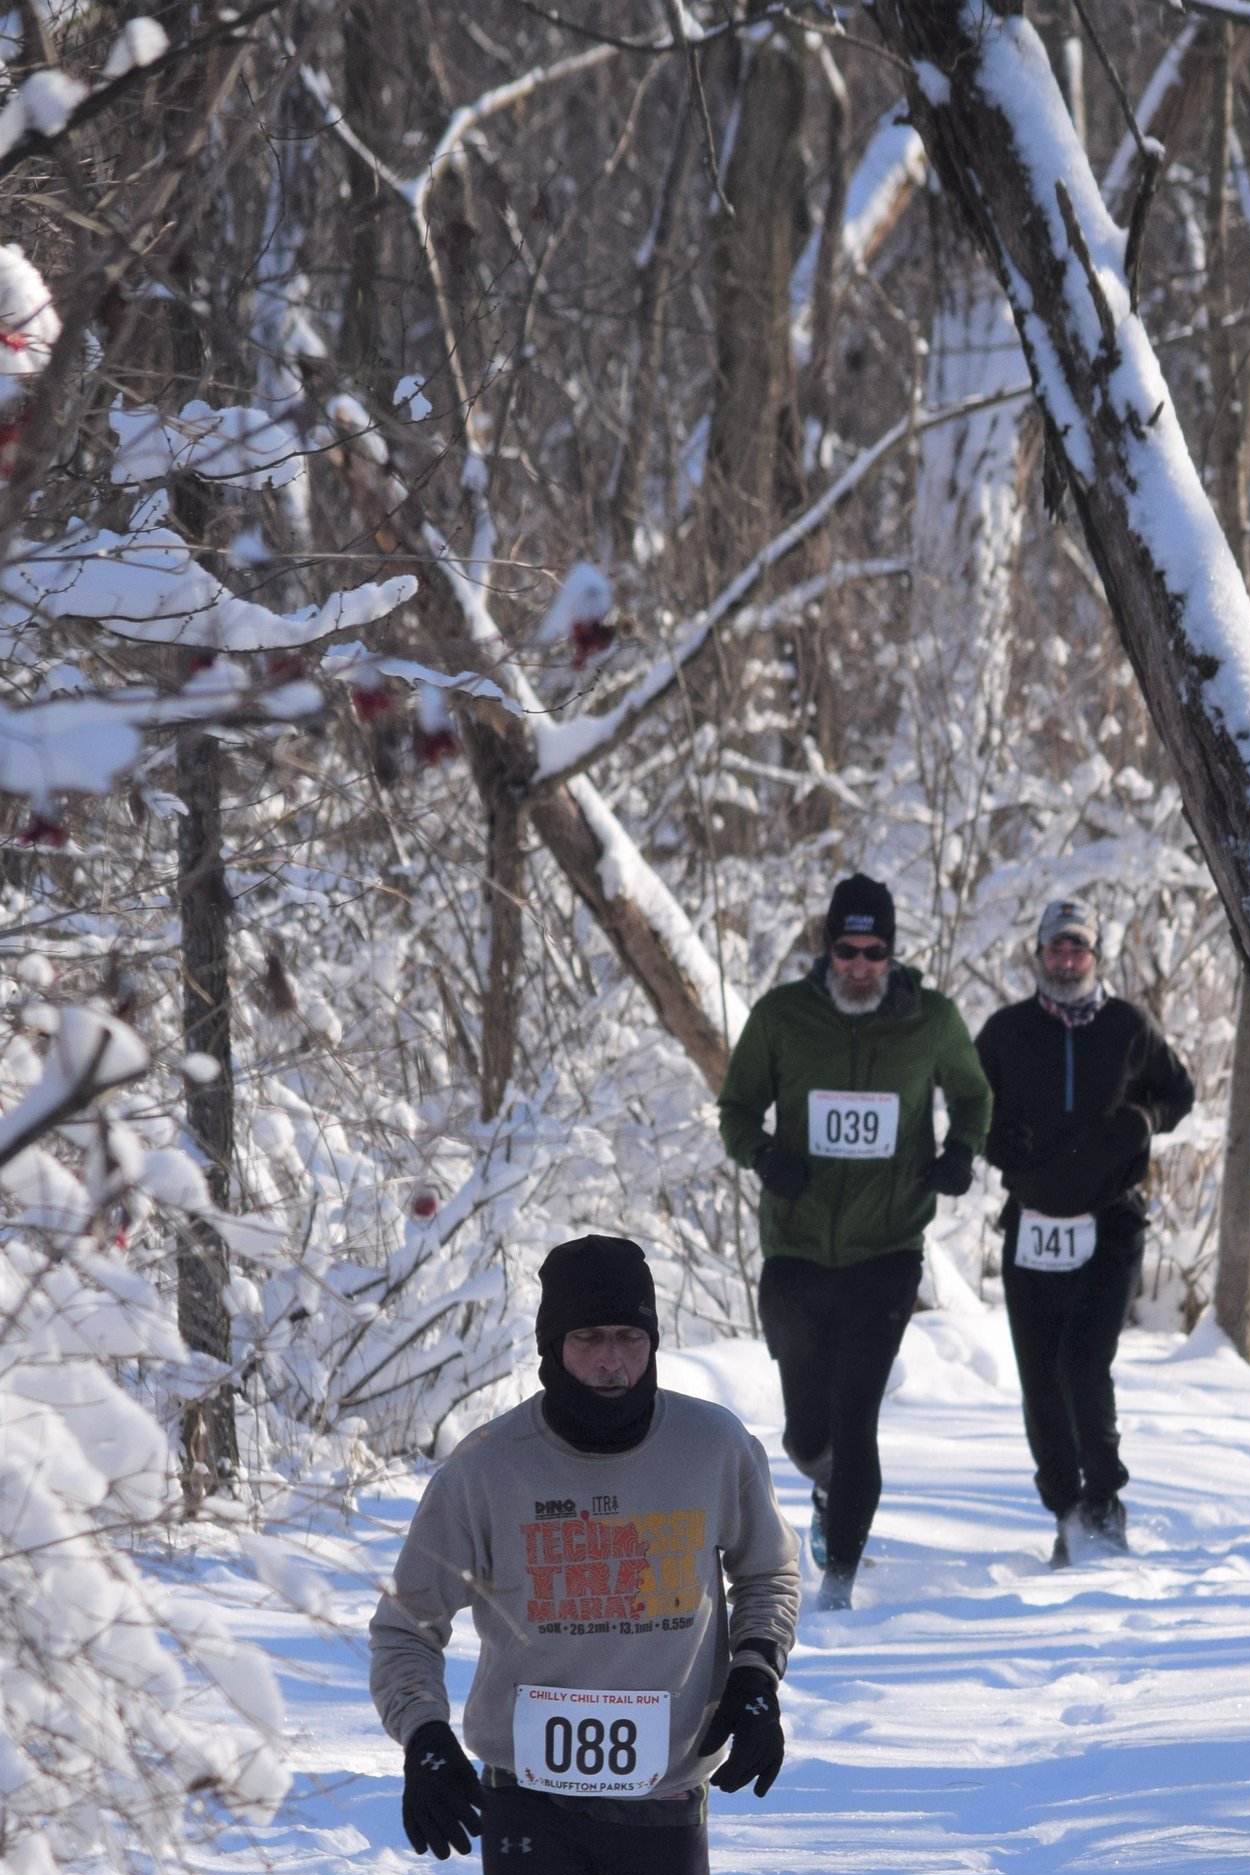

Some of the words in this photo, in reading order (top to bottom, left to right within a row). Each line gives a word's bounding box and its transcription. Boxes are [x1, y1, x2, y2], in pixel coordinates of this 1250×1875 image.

[826, 1109, 879, 1144] 039
[535, 1499, 576, 1514] DINO
[525, 1553, 699, 1601] TRAIL
[539, 1622, 562, 1634] 50K
[570, 1620, 610, 1635] 26.2mi
[620, 1621, 653, 1635] 13.1mi
[529, 1690, 568, 1702] CHILLY
[570, 1694, 600, 1704] CHILI
[603, 1695, 634, 1704] TRAIL
[636, 1695, 660, 1704] RUN
[545, 1716, 637, 1775] 088
[545, 1779, 597, 1791] BLUFFTON
[600, 1782, 635, 1791] PARKS
